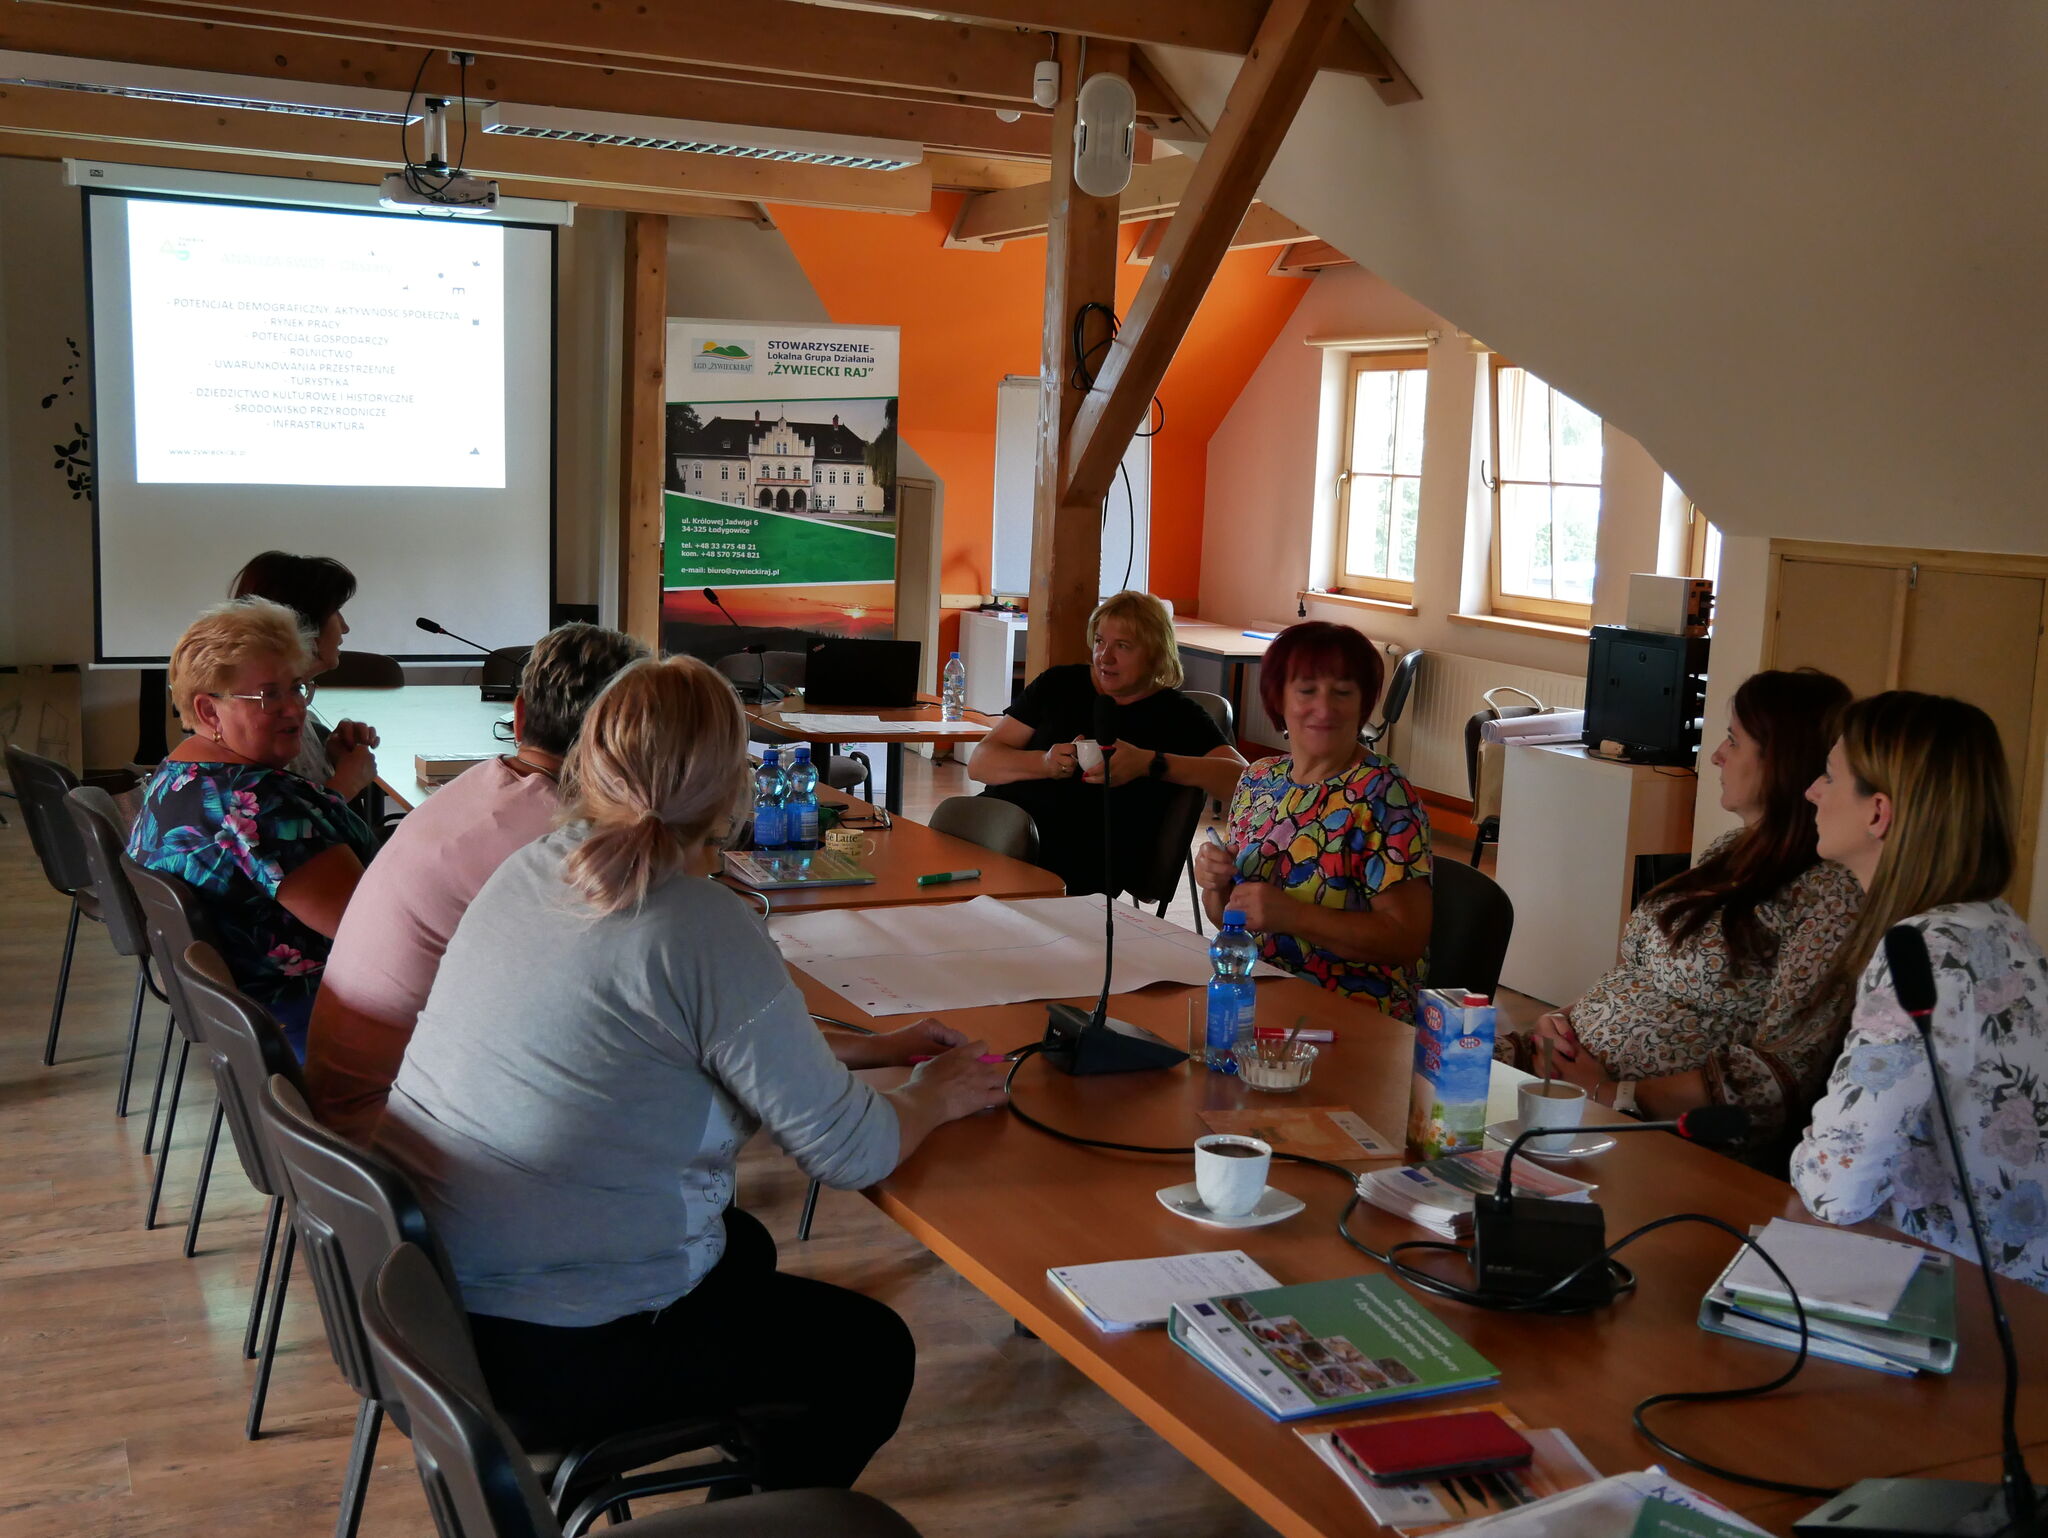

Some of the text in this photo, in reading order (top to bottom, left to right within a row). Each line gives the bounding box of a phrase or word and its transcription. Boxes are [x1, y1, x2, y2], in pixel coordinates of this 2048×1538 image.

[173, 298, 234, 310] POTENCJAŁ
[270, 317, 341, 330] RYNEK PRACY
[251, 331, 390, 346] POTENCJAŁ GOSPODARCZY
[289, 347, 353, 359] ROLNICTWO
[767, 352, 875, 364] Lokalna Grupa Działania
[214, 360, 396, 375] UWARUNKOWANIA PRZESTRZENNE
[290, 376, 349, 387] TURYSTYKA
[196, 388, 269, 400] DZIEDZICTWO
[272, 391, 337, 402] KULTUROWE
[346, 393, 414, 404] HISTORYCZNE
[310, 406, 387, 417] PRZYRODNICZE
[272, 419, 365, 431] INFRASTRUKTURA
[692, 518, 724, 526] Królowej
[725, 518, 752, 527] Jadwigi
[708, 526, 750, 535] Łodygowice
[707, 567, 780, 577] biuro@zywieckiraj.pl
[835, 833, 859, 843] Latte
